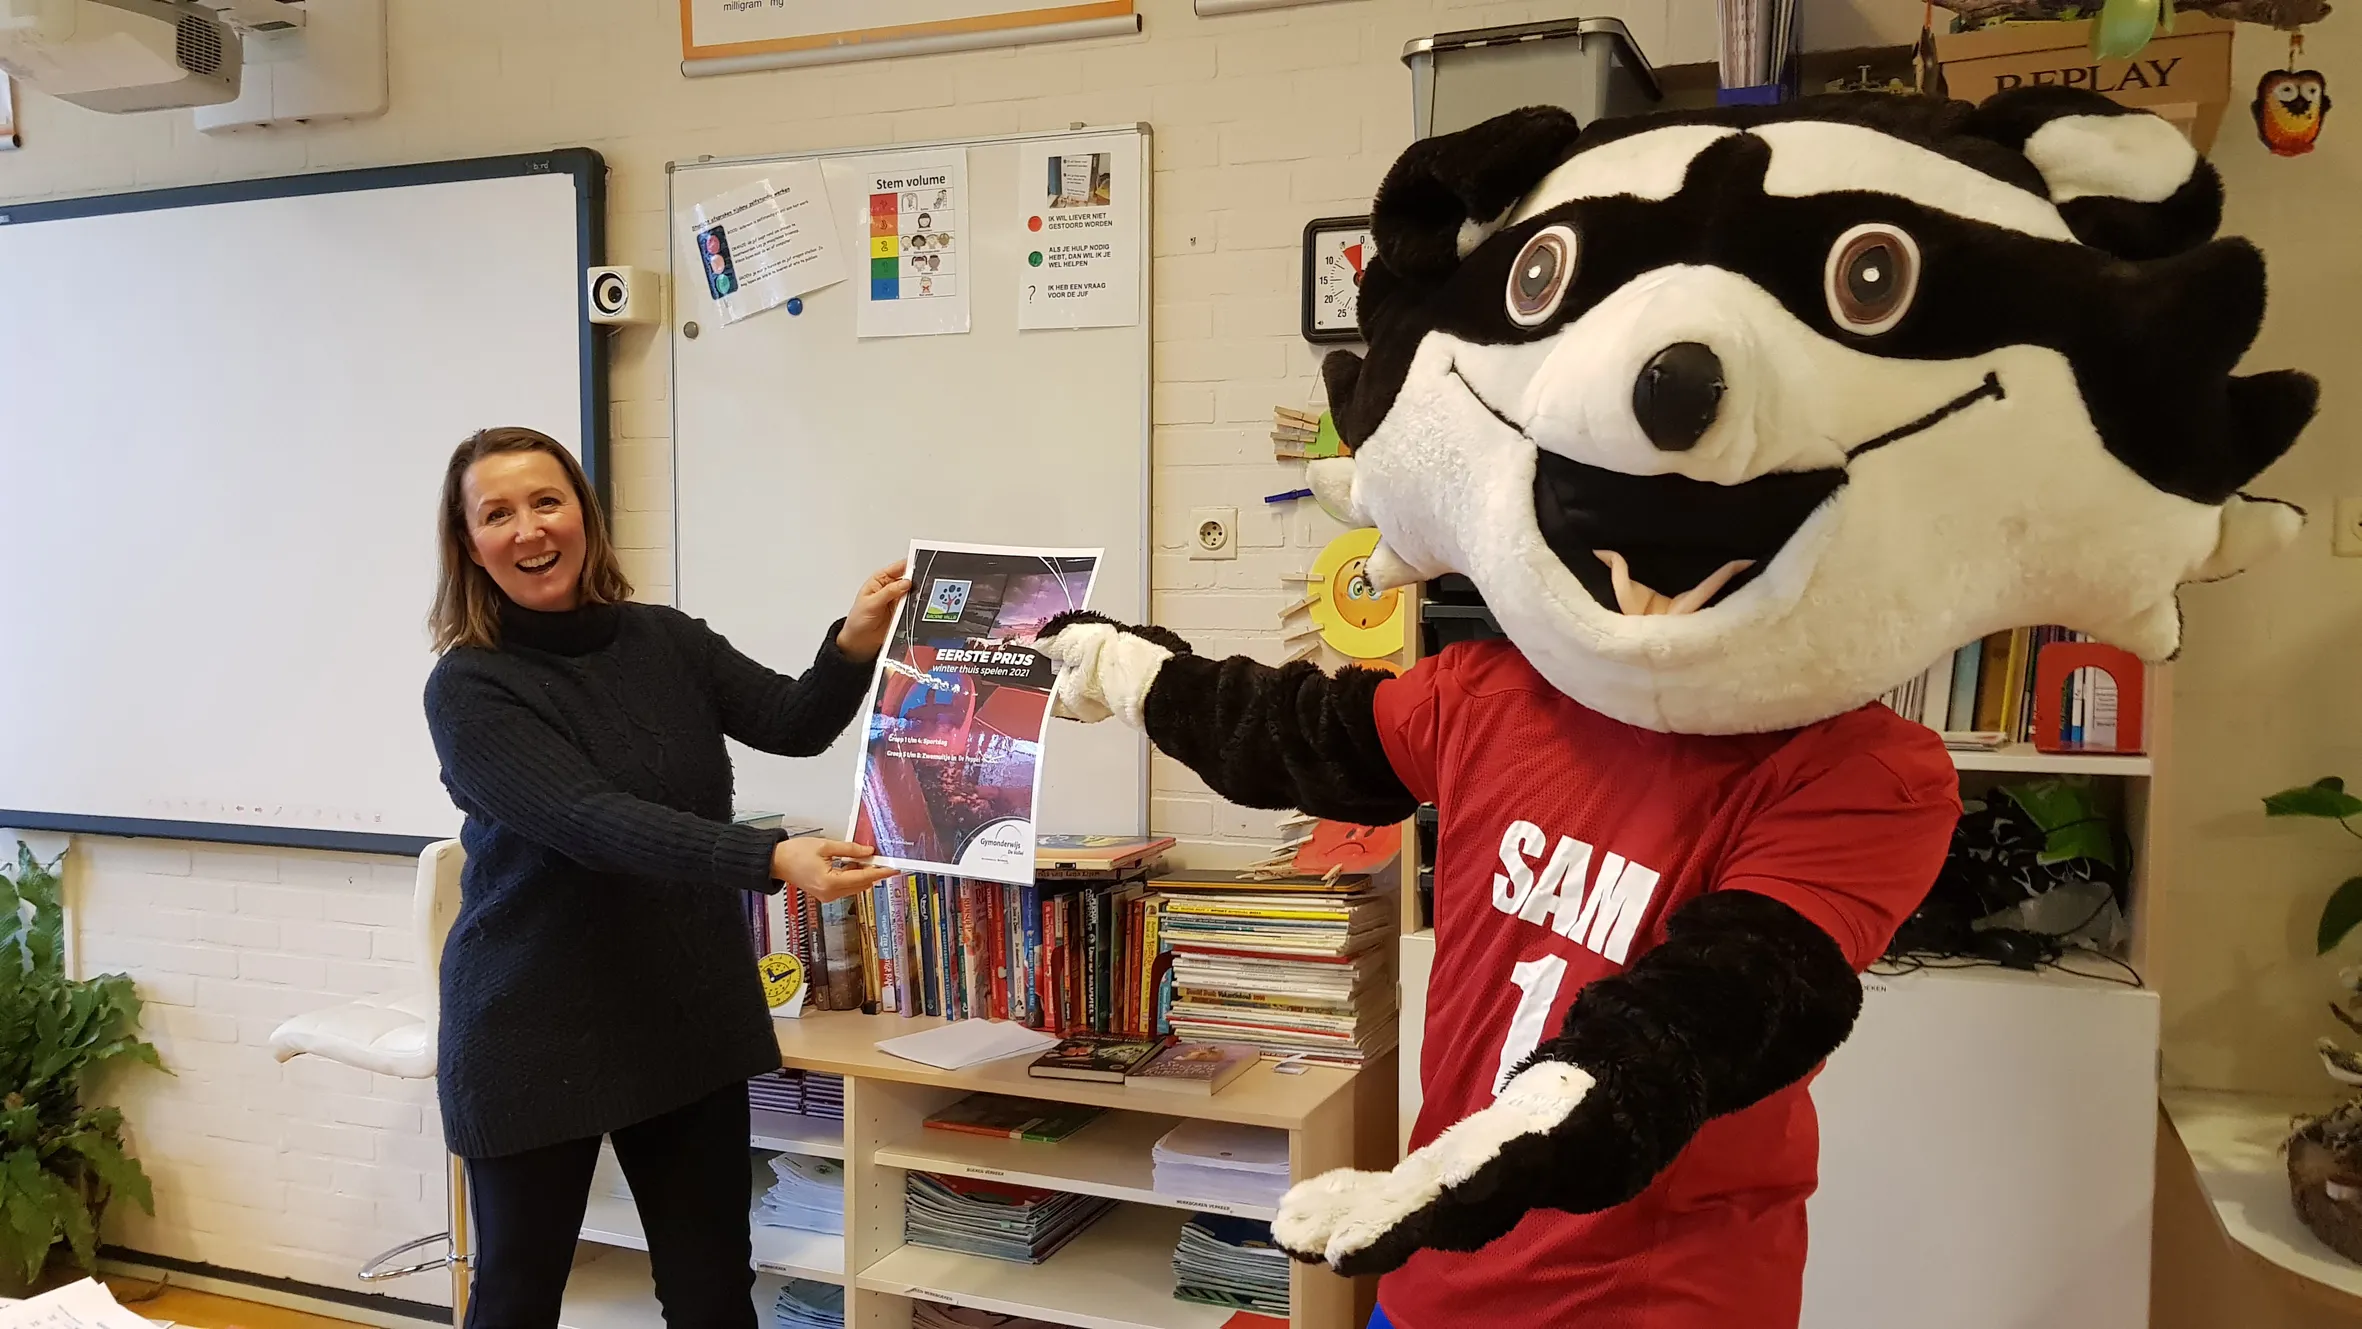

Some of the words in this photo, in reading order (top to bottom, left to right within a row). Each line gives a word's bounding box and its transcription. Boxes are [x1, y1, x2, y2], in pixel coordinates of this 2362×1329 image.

[723, 0, 762, 12] milligram
[1994, 57, 2182, 94] REPLAY
[876, 179, 904, 190] Stem
[906, 175, 946, 187] volume
[1069, 213, 1092, 221] LIEVER
[1048, 222, 1084, 230] GESTOORD
[1084, 220, 1113, 228] WORDEN
[1359, 235, 1365, 245] 0
[880, 240, 889, 252] 2
[1071, 244, 1089, 252] HULP
[1089, 243, 1110, 251] NODIG
[1325, 256, 1334, 265] 10
[1319, 276, 1329, 285] 15
[1076, 290, 1089, 298] JUF
[1324, 295, 1334, 304] 20
[1337, 309, 1347, 318] 25
[936, 648, 991, 663] EERSTE
[991, 651, 1035, 666] PRIJS
[932, 664, 958, 673] winter
[959, 665, 980, 674] thuis
[980, 667, 1008, 676] spelen
[1009, 668, 1030, 677] 2021
[923, 738, 948, 747] Sportdag
[980, 837, 1021, 850] Gymonderwijs
[1492, 819, 1660, 966] SAM
[1491, 953, 1568, 1098] 1
